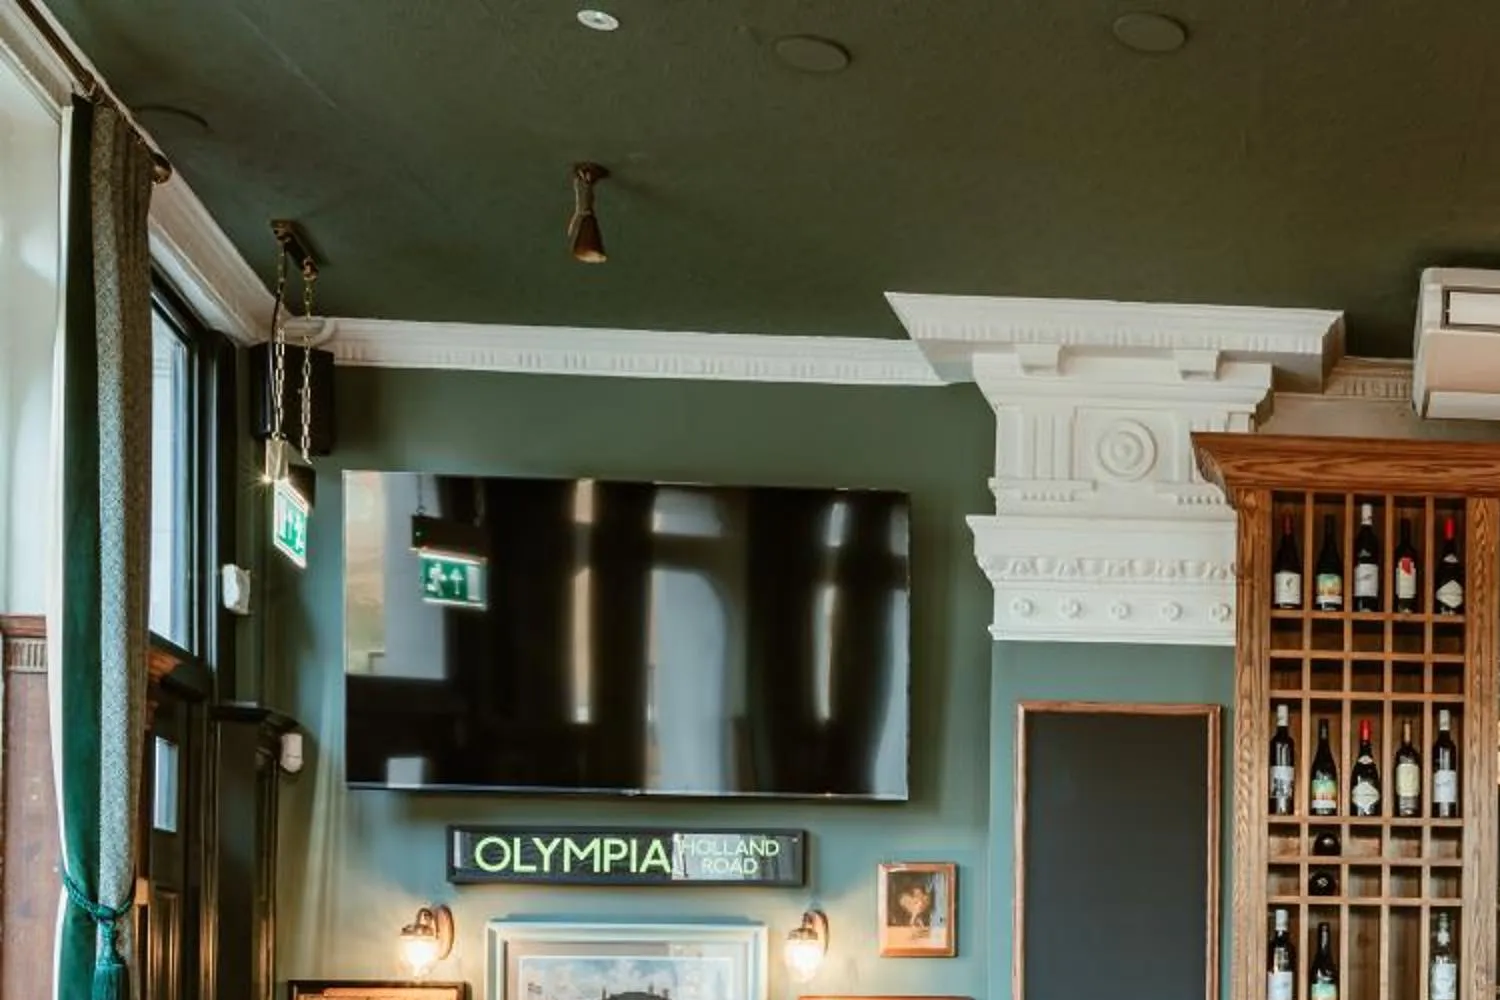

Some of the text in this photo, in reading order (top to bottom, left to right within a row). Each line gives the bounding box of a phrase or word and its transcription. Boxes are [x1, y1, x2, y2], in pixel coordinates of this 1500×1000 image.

[474, 836, 672, 874] OLYMPIA
[683, 838, 779, 857] HOLLAND
[702, 857, 759, 875] ROAD
